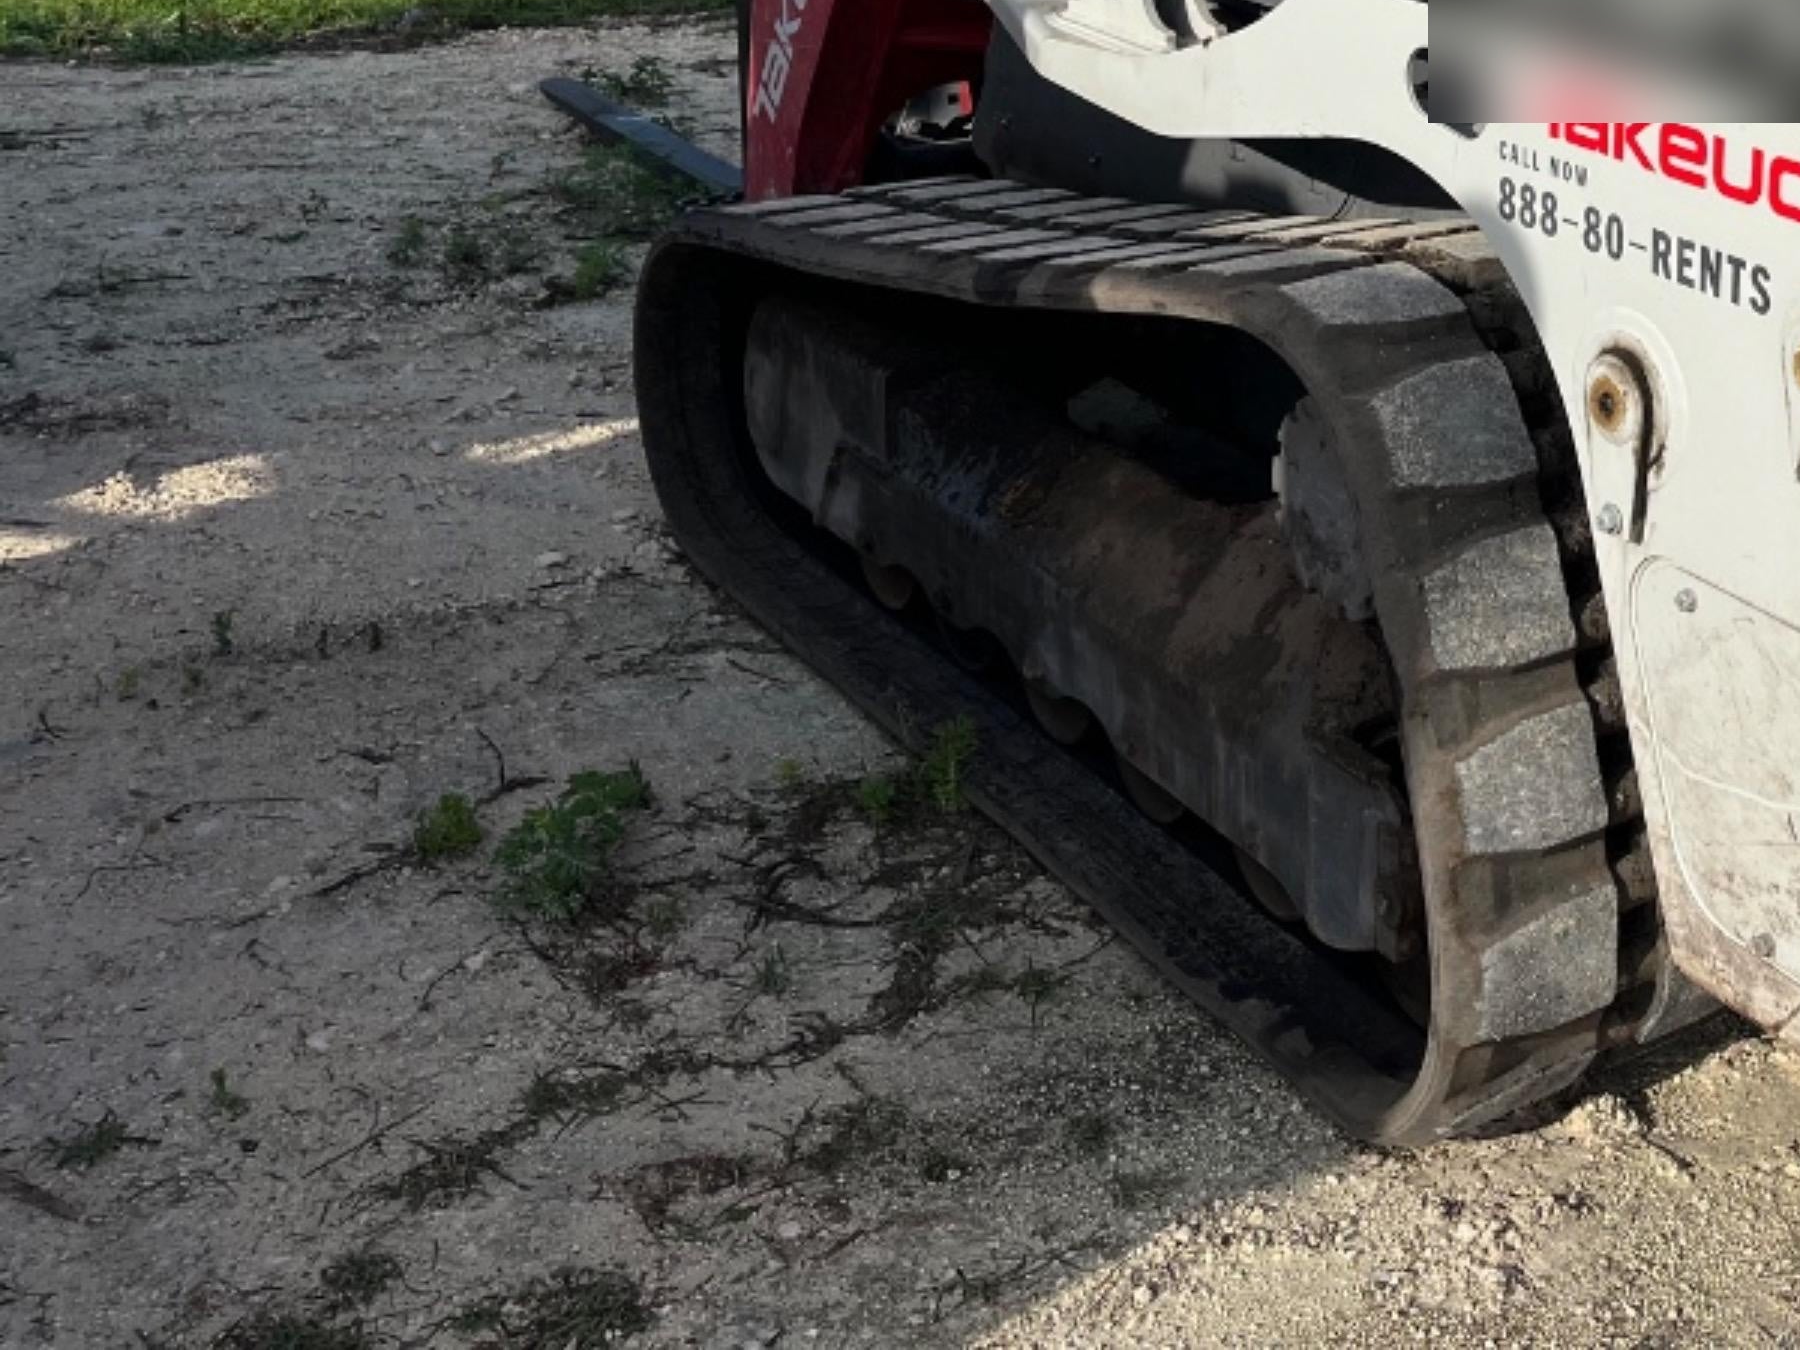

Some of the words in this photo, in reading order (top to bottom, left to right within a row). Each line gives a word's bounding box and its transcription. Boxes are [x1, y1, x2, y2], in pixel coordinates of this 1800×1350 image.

[1499, 140, 1540, 172] CALL
[1549, 155, 1588, 187] NOW
[1498, 176, 1772, 317] 888-80-RENTS
